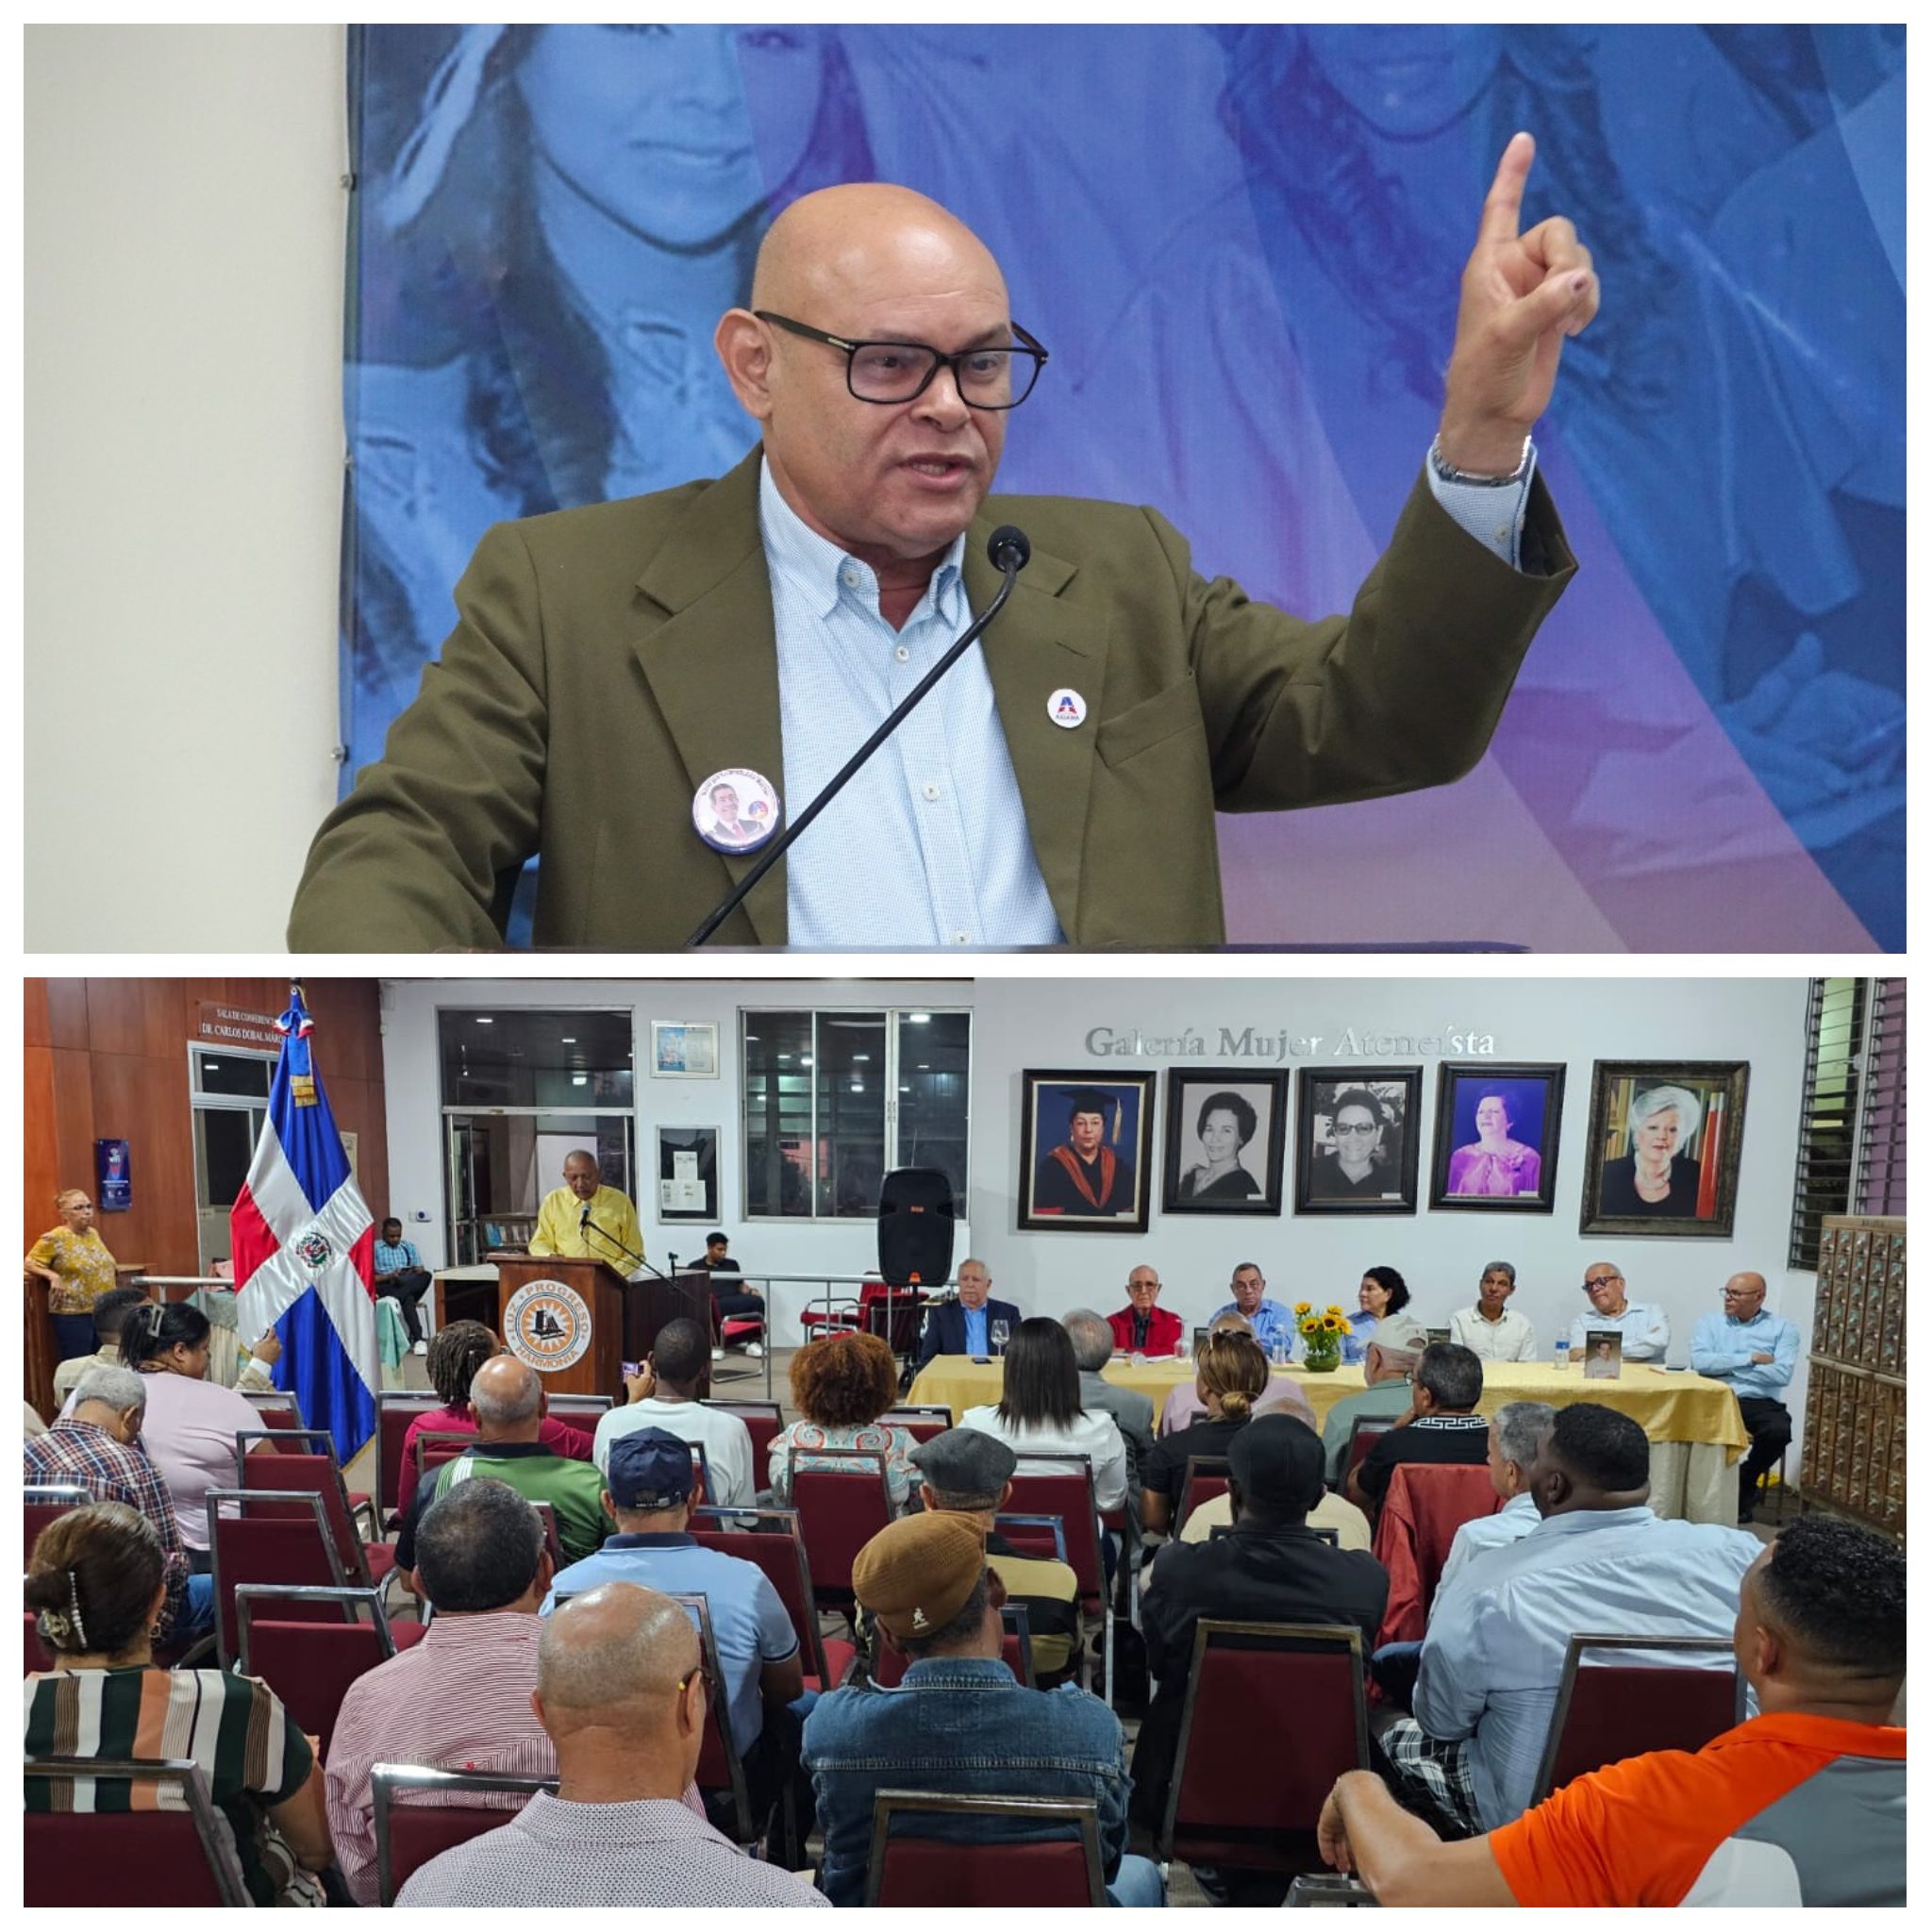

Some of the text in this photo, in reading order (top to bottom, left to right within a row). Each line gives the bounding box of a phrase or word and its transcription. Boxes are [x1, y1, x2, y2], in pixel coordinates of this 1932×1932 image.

[214, 1024, 242, 1038] CARLOS
[1085, 1024, 1494, 1063] Galería Mujer Ateneísta
[507, 1301, 517, 1333] LUZ
[525, 1283, 589, 1332] PROGRESO
